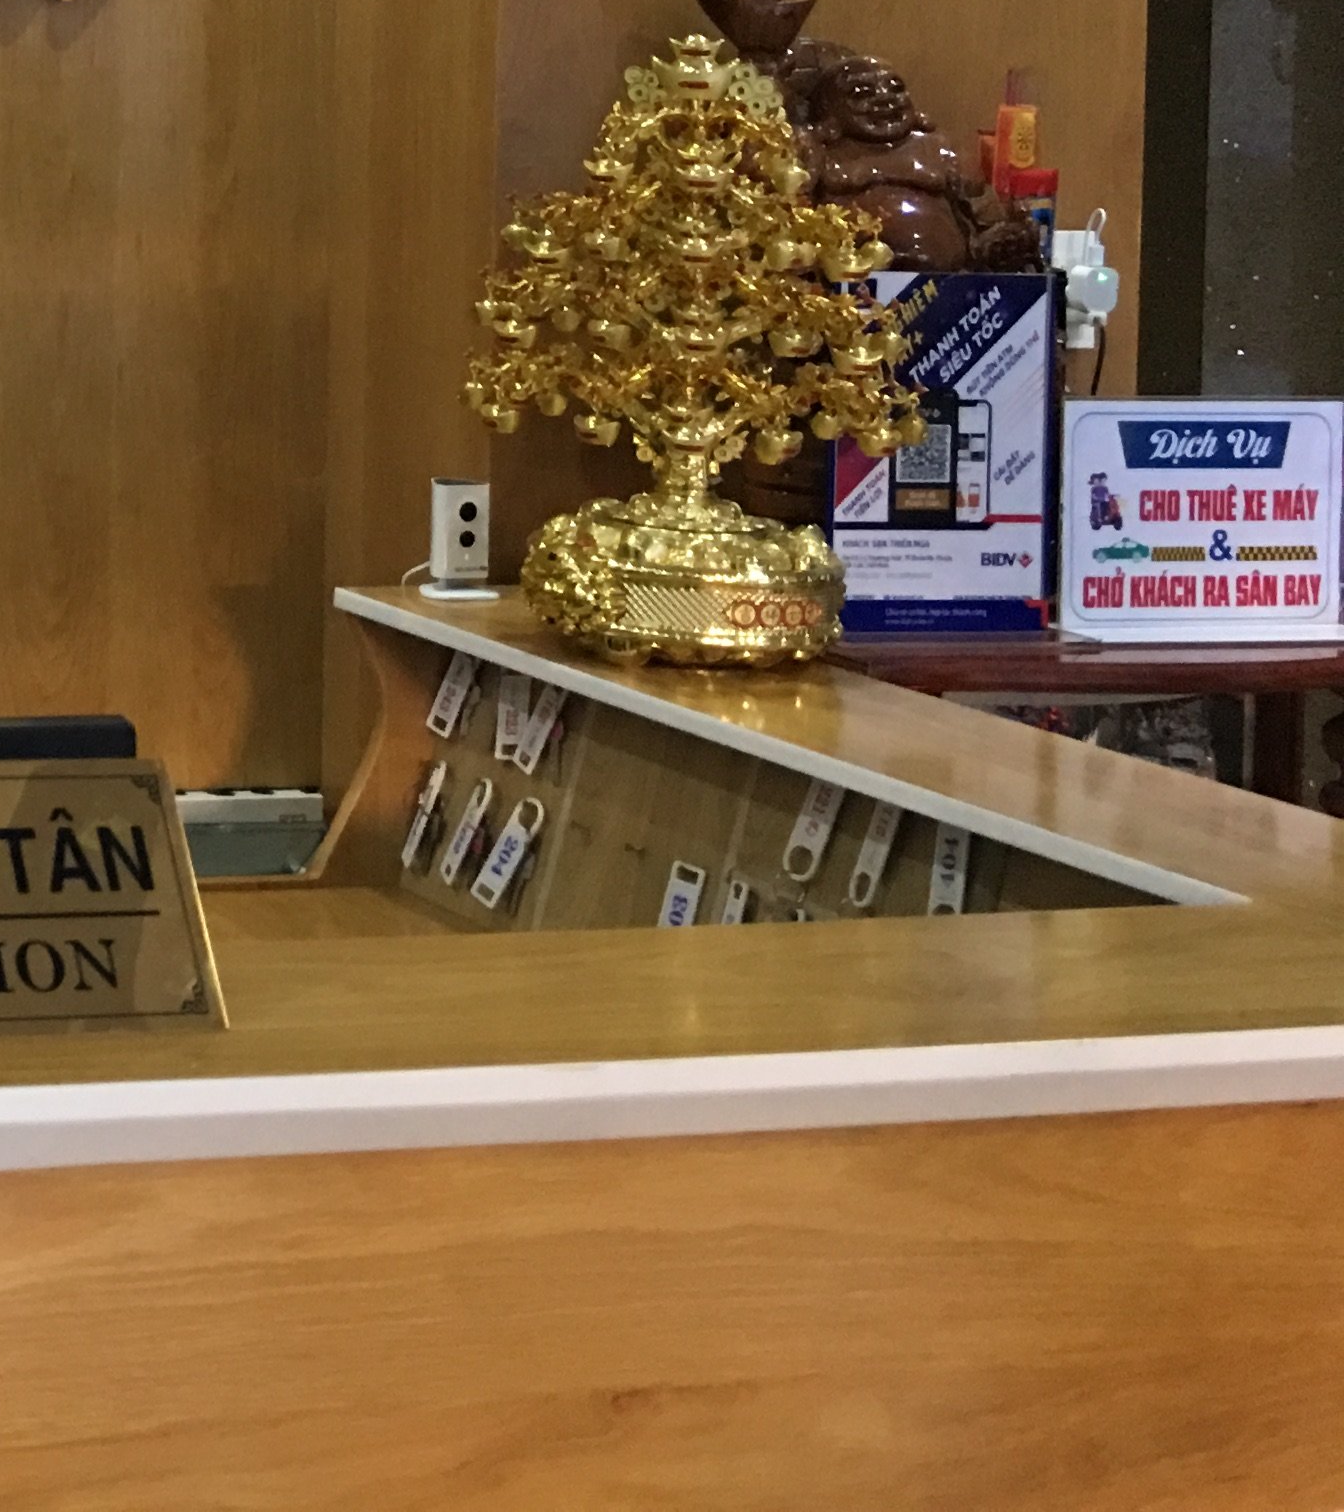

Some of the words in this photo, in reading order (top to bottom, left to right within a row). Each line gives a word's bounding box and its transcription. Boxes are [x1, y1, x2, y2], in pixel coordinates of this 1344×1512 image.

[909, 326, 960, 384] THANH
[959, 285, 1002, 332] TOÁN
[940, 342, 972, 384] SIÊU
[971, 311, 1004, 348] TỐC
[1149, 428, 1219, 465] Dịch
[1225, 428, 1274, 465] Vụ
[1139, 490, 1181, 522] CHO
[1187, 483, 1238, 522] THUÊ
[1242, 489, 1268, 522] XE
[1272, 483, 1320, 522] MÁY
[980, 552, 1017, 568] BIDV
[1208, 528, 1233, 562] &
[1082, 566, 1126, 609] CHỞ
[1130, 569, 1198, 608] KHÁCH
[1203, 575, 1231, 608] RA
[1235, 569, 1279, 607] SÂN
[1283, 574, 1322, 607] BAY
